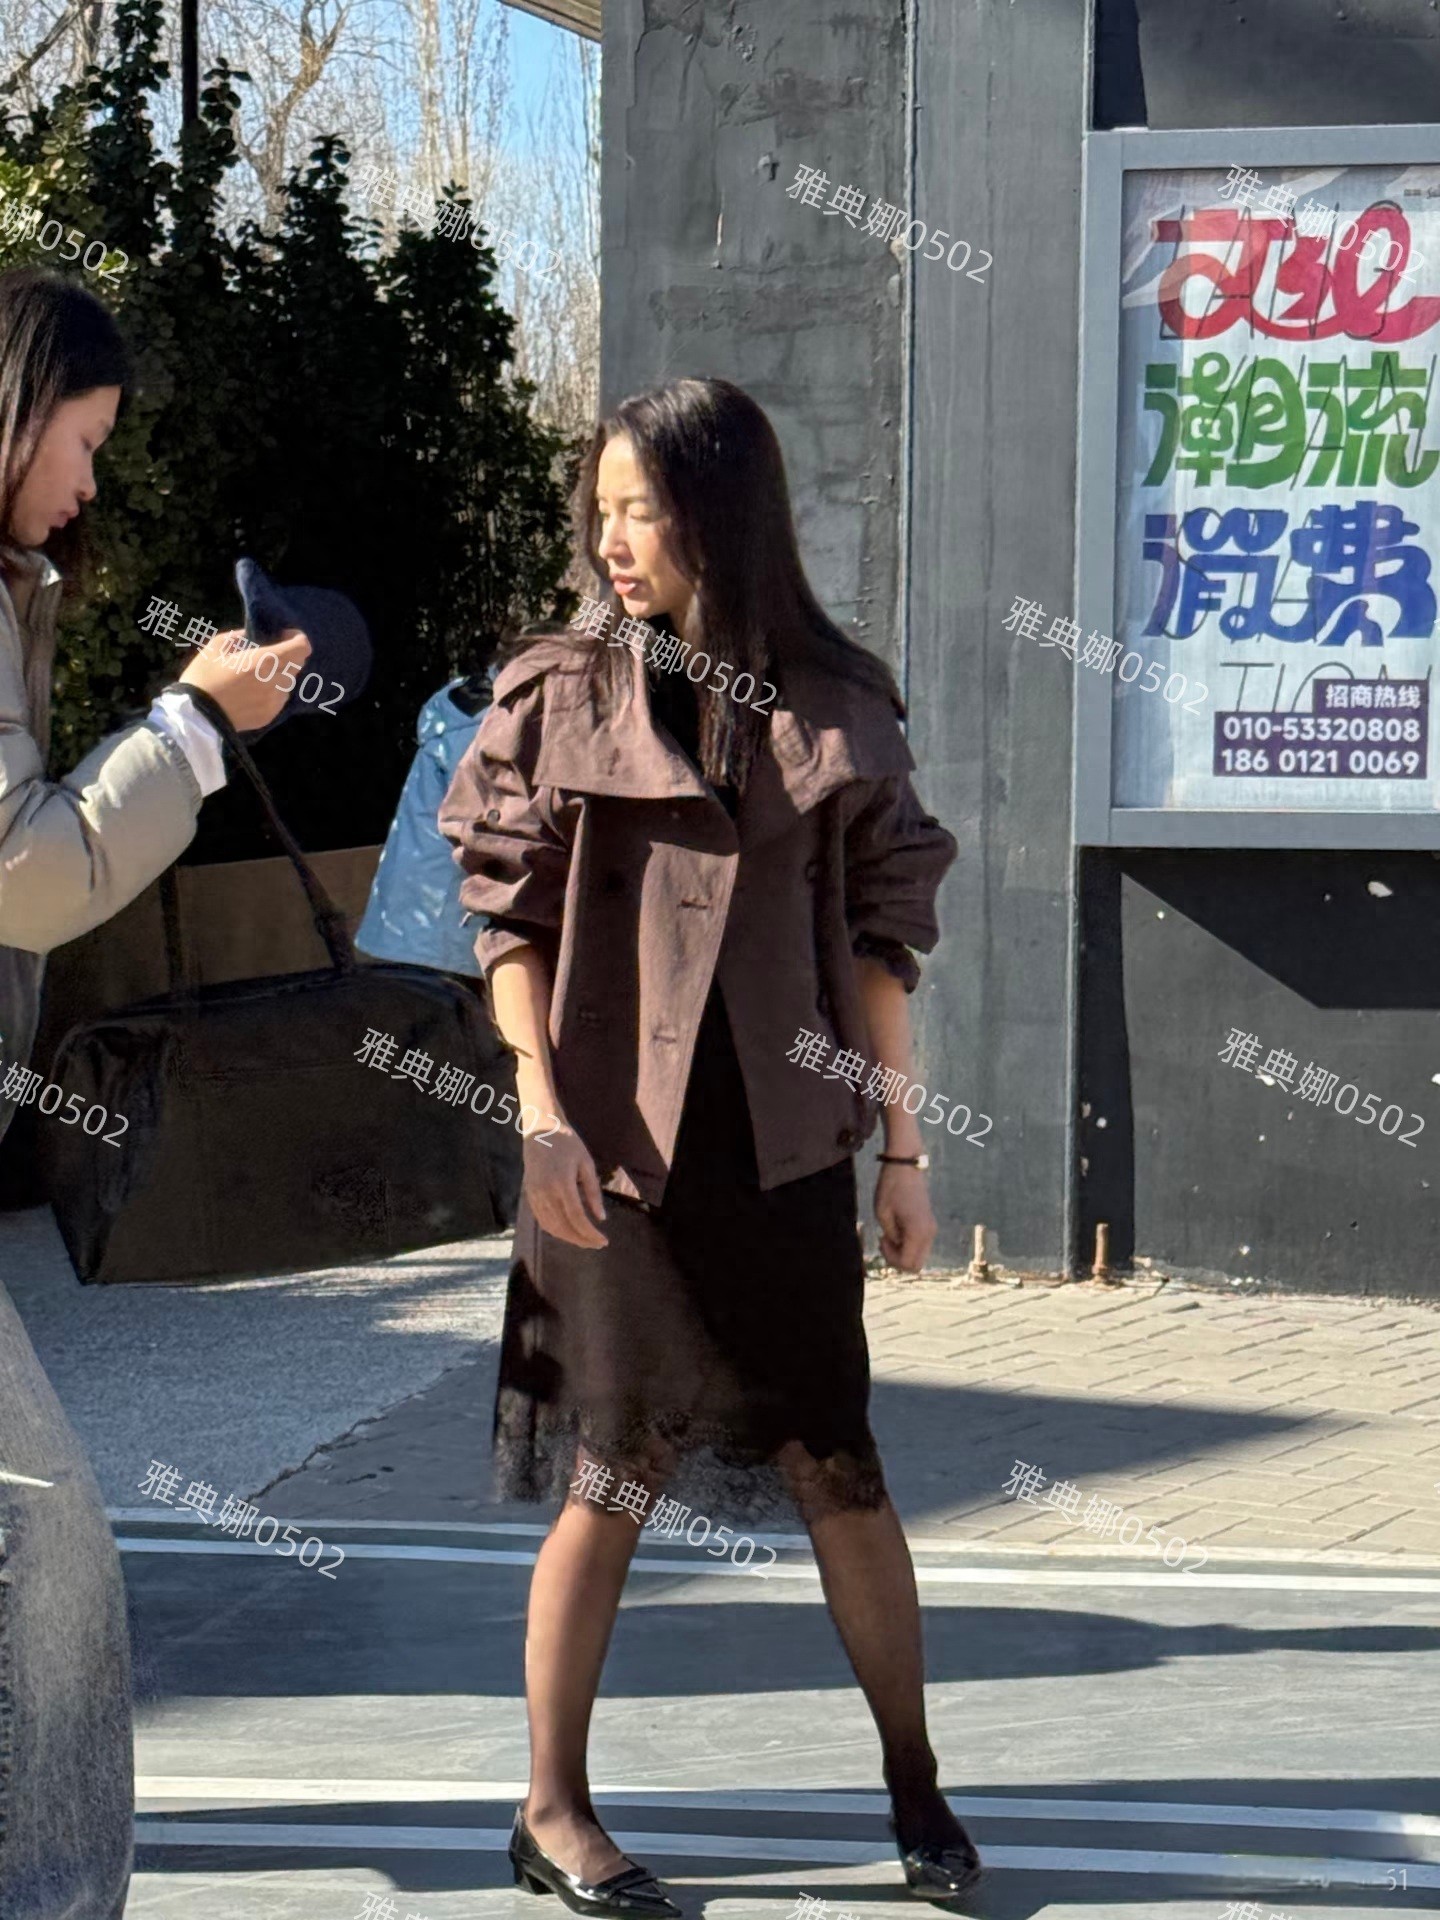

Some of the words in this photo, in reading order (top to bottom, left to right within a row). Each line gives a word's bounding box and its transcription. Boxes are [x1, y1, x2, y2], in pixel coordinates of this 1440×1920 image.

[1141, 350, 1440, 490] 潮流
[1141, 500, 1438, 648] 消费
[1325, 683, 1421, 709] 招商热线
[1223, 716, 1421, 743] 010-53320808
[1221, 748, 1270, 773] 186
[1278, 750, 1339, 773] 0121
[1349, 750, 1420, 775] 0069
